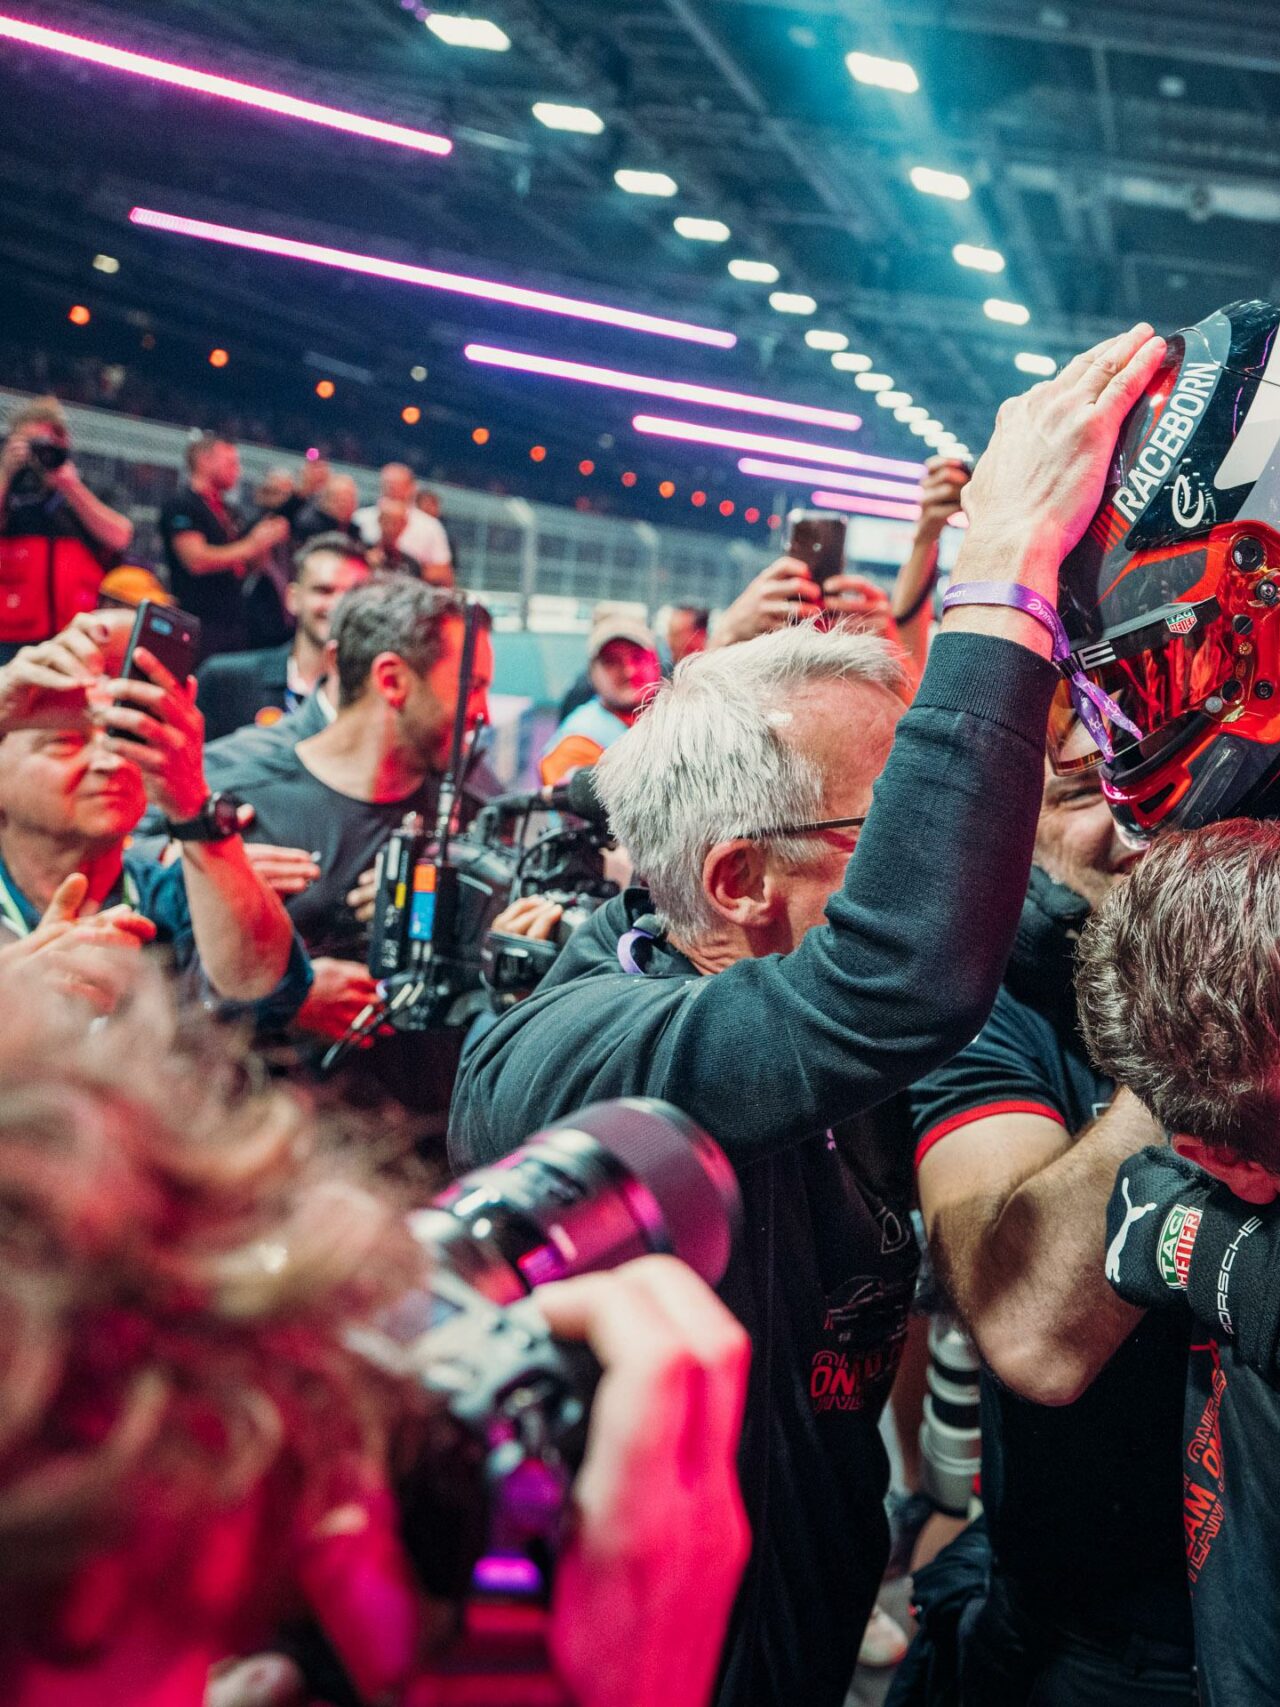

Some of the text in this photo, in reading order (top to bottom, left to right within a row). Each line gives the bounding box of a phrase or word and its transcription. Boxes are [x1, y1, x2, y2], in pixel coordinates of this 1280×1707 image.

[1112, 361, 1221, 522] RACEBORN
[1170, 608, 1194, 624] TAG
[1162, 1215, 1185, 1280] TAG
[1217, 1215, 1263, 1336] PORSCHE
